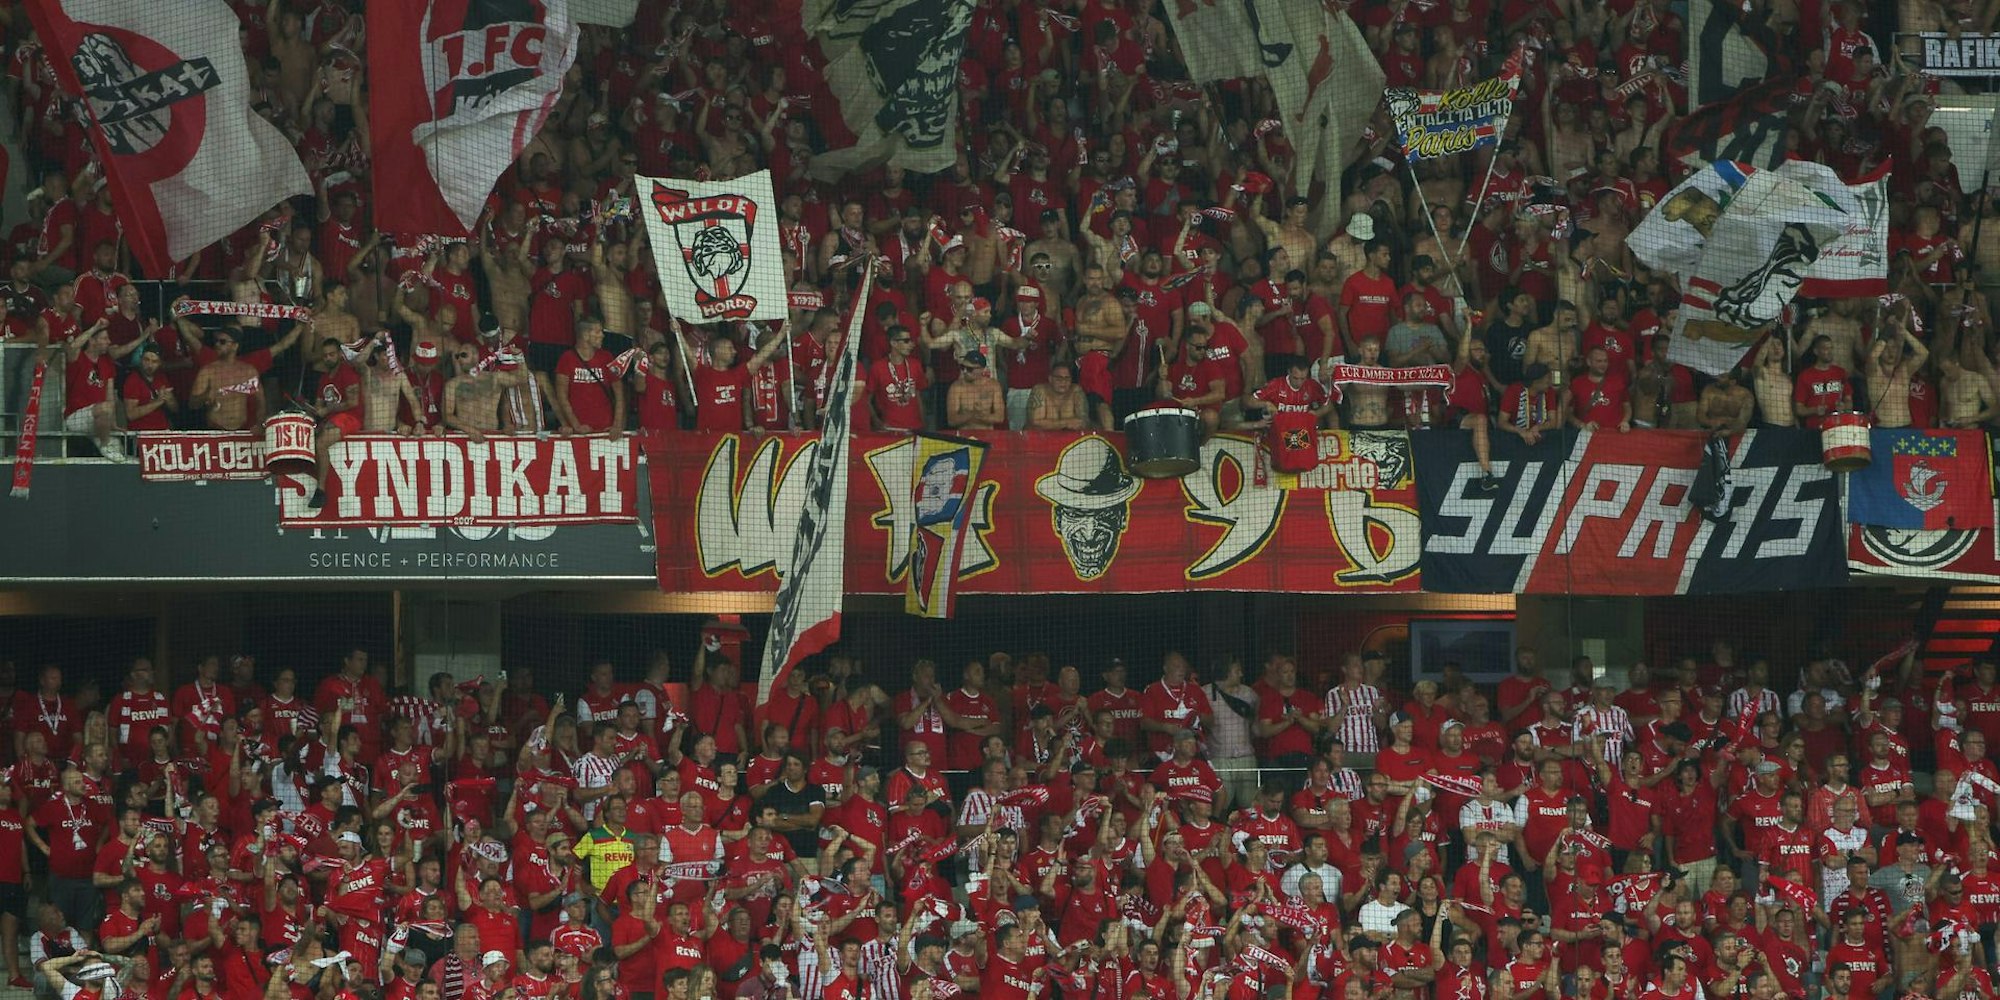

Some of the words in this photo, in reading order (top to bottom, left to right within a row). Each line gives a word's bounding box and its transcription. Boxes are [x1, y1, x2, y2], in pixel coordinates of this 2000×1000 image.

[1407, 125, 1478, 158] Paris
[199, 300, 294, 319] SYNDIKAT
[702, 298, 754, 316] HORDE
[1340, 366, 1361, 378] FÜR
[1362, 369, 1394, 380] IMMER
[1418, 367, 1446, 379] KÖLN
[142, 440, 265, 472] KÖLN-OST
[453, 516, 475, 526] 2007
[309, 552, 392, 568] SCIENCE
[417, 552, 559, 568] PERFORMANCE
[695, 776, 719, 791] REW
[822, 783, 844, 793] REW
[1168, 776, 1200, 787] REWE
[1875, 780, 1902, 793] REWE
[1258, 834, 1289, 846] REWE
[1779, 844, 1811, 856] REWE
[604, 852, 634, 863] REWE
